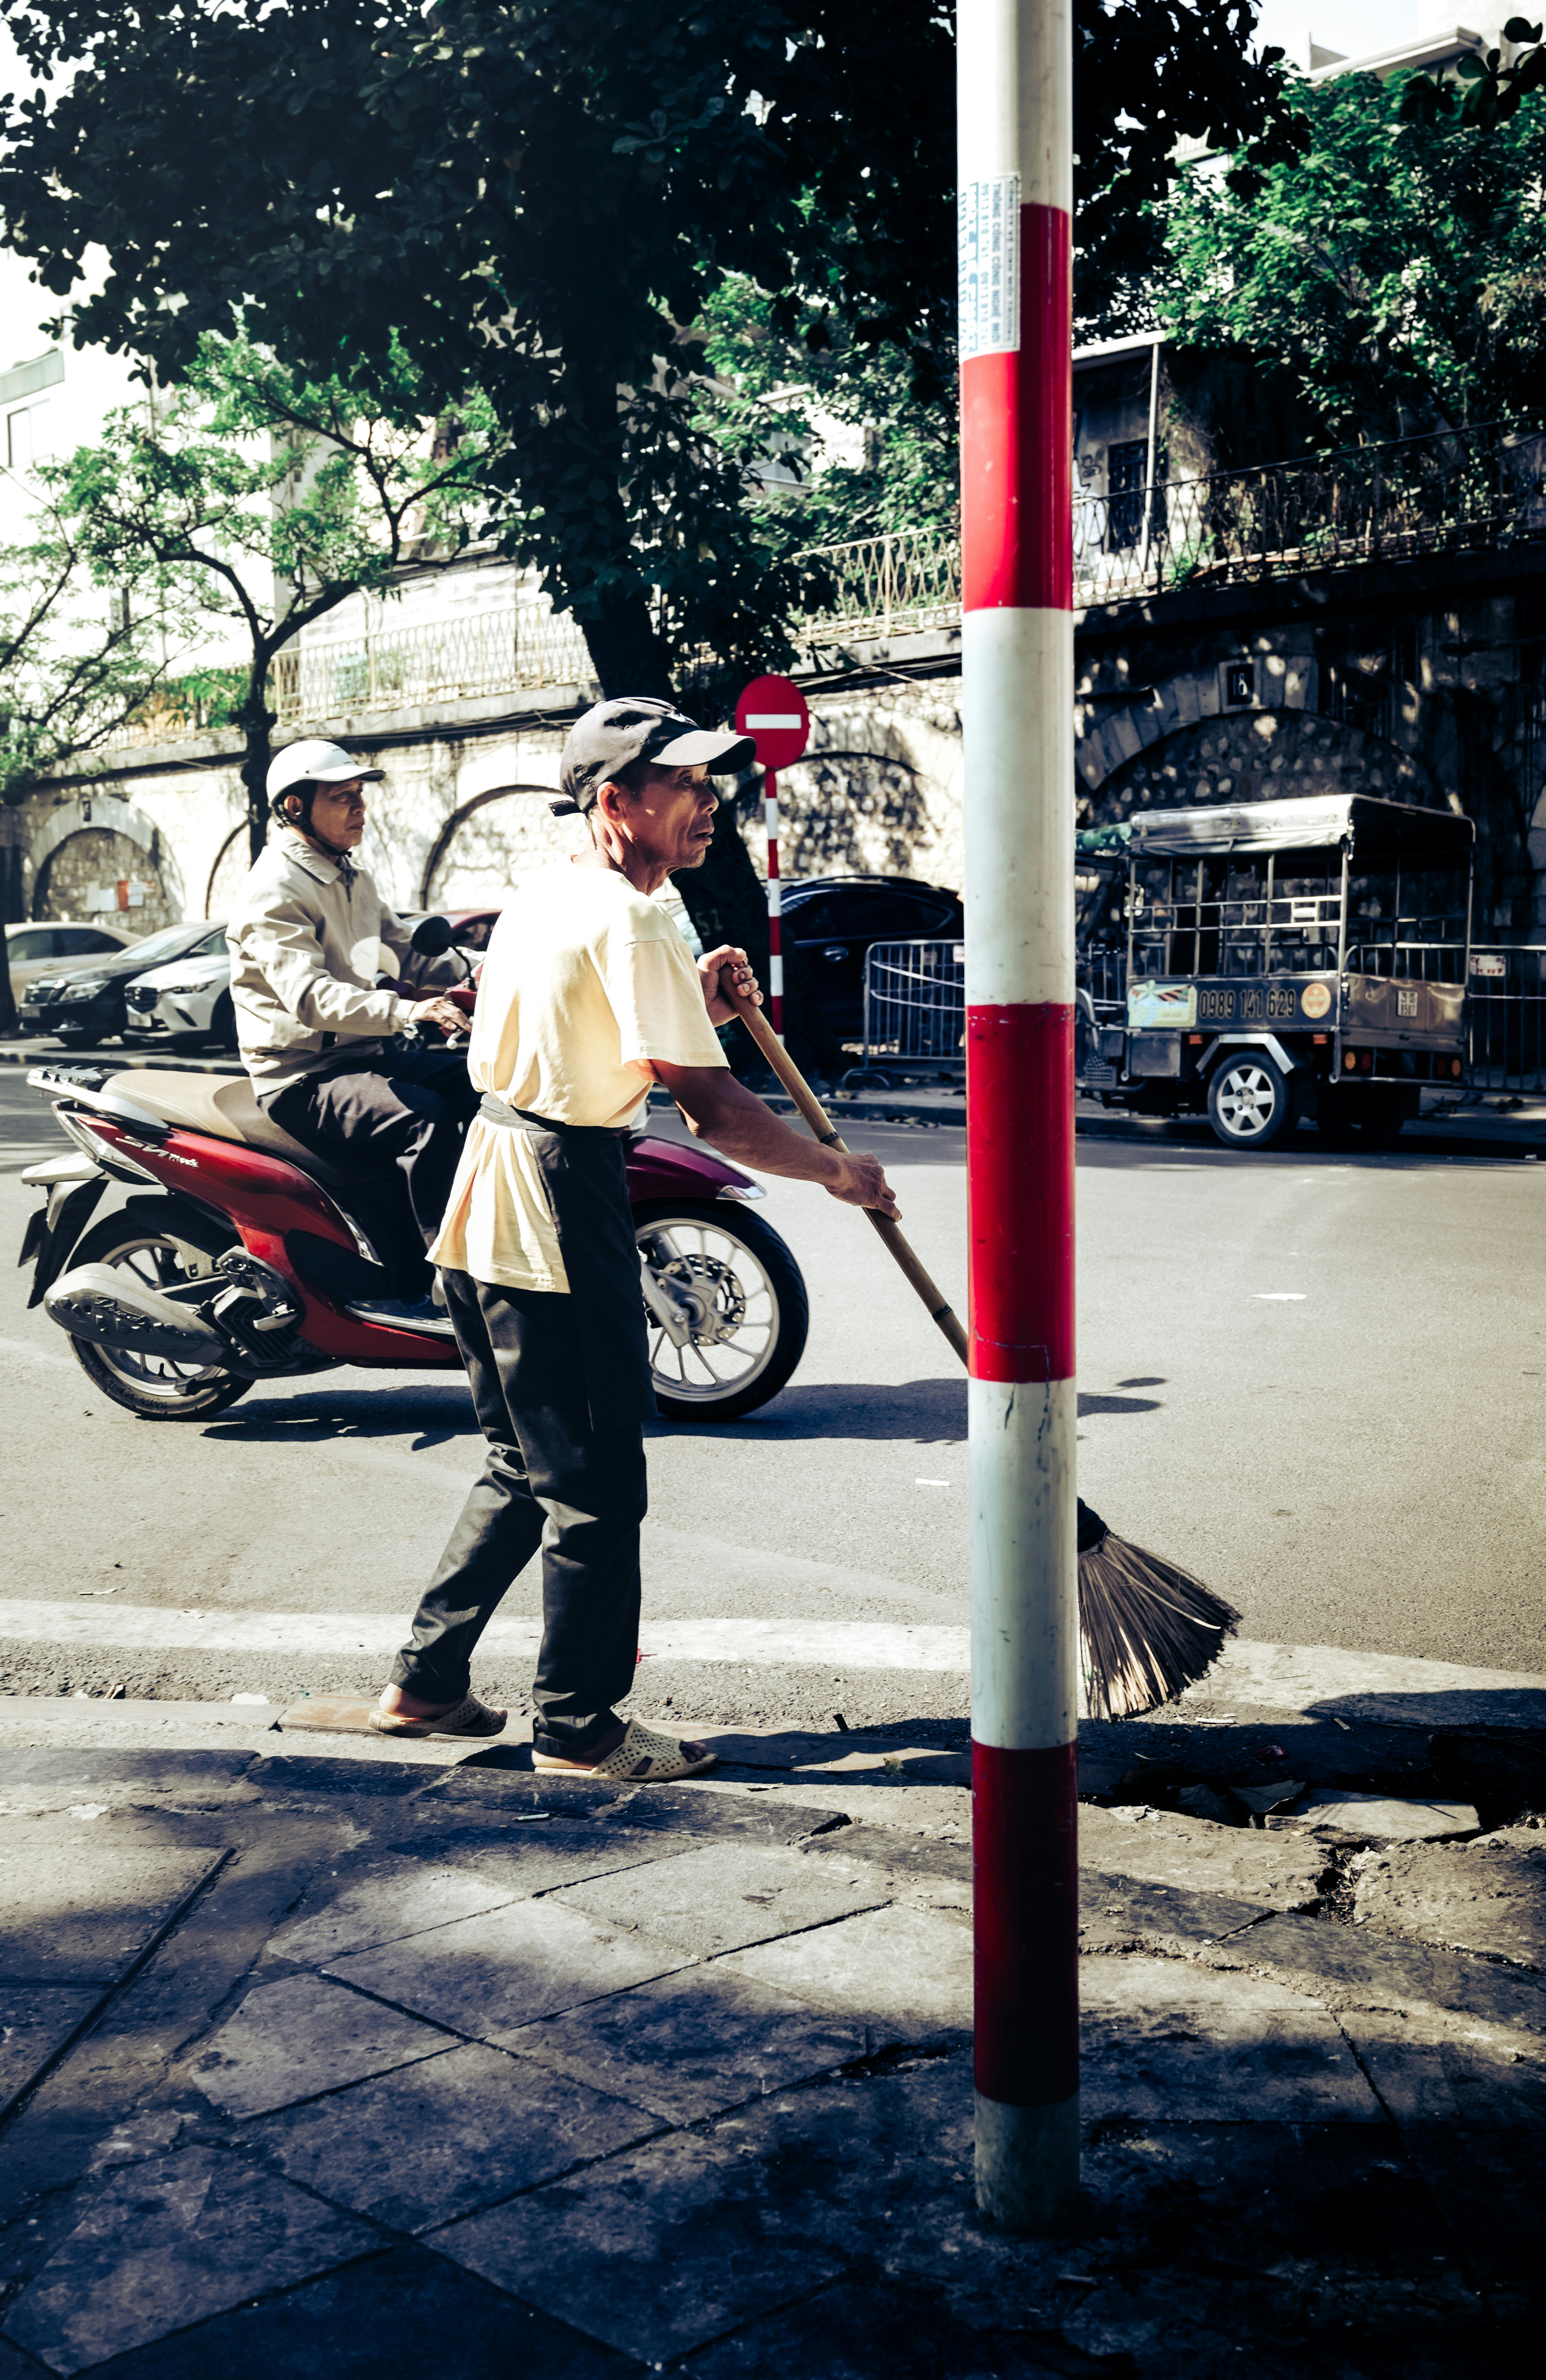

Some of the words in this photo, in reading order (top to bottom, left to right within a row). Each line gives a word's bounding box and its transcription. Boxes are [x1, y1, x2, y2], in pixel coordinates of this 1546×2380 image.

[1232, 672, 1248, 696] 18
[1200, 989, 1235, 1019] 0989
[1239, 989, 1263, 1018] 141
[1266, 988, 1296, 1019] 629
